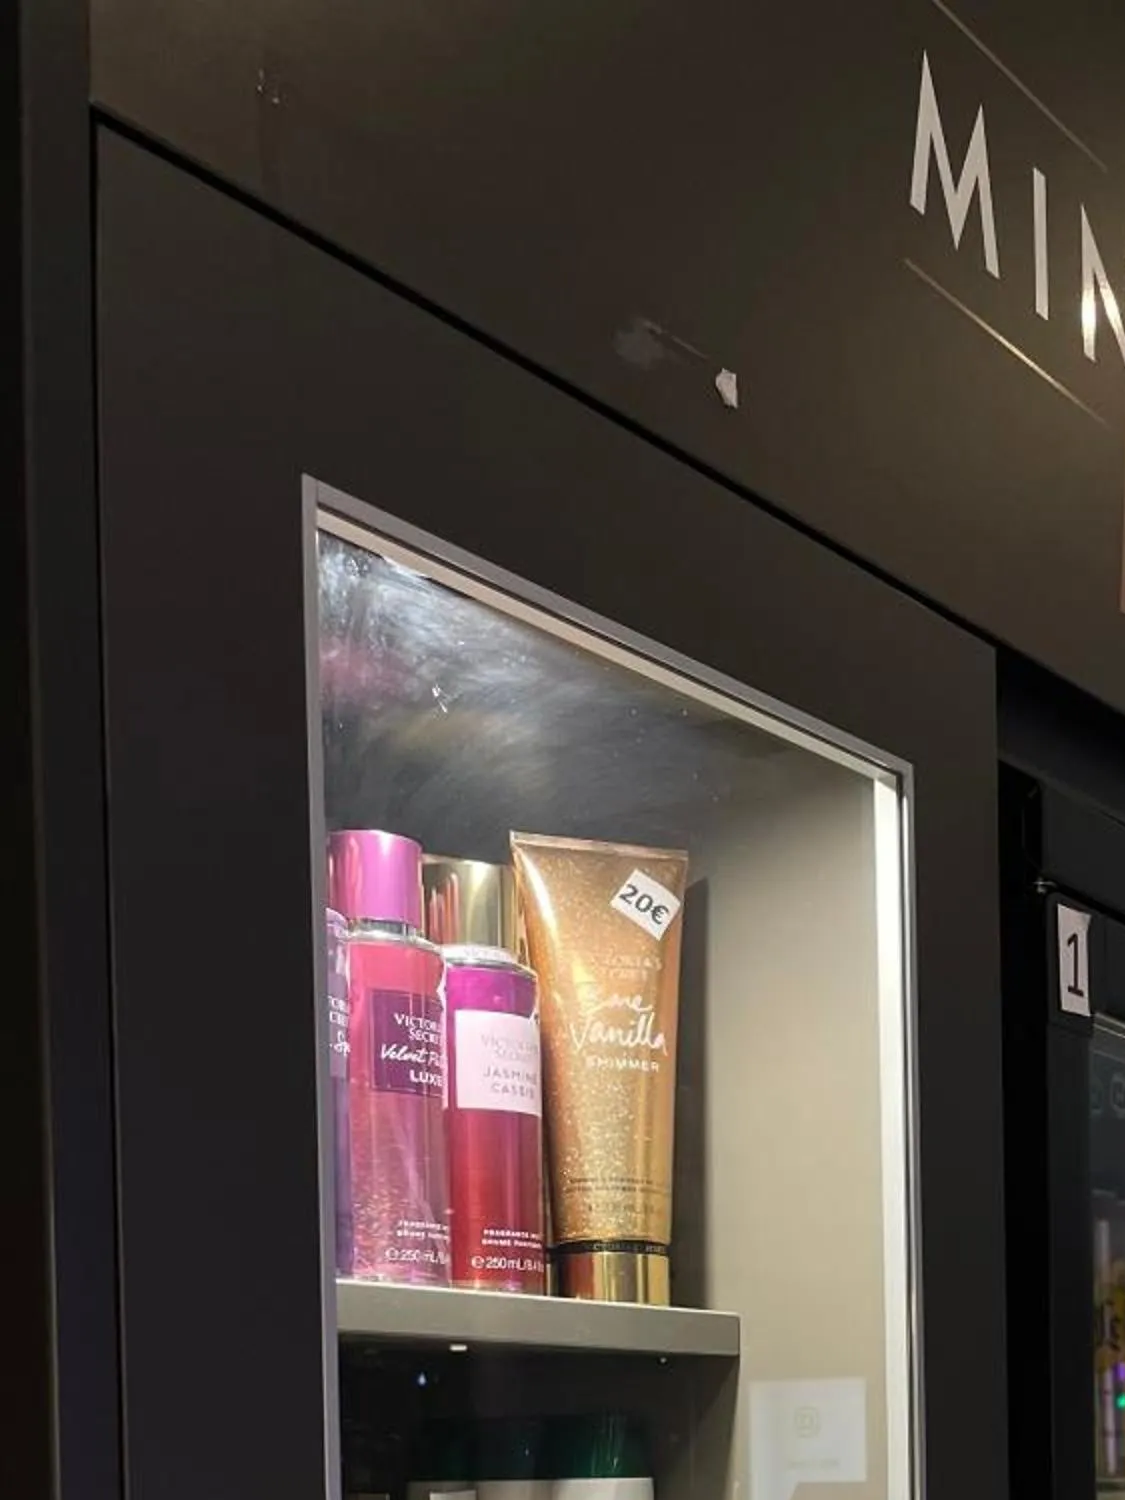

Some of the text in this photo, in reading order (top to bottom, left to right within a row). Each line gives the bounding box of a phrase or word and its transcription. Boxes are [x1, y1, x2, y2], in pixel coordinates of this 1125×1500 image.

[618, 884, 670, 925] 20€
[1066, 932, 1085, 998] 1
[569, 1010, 669, 1057] Vanilla
[381, 1043, 427, 1064] Velvet
[587, 1054, 661, 1074] SHIMMER
[409, 1068, 443, 1087] LUXE
